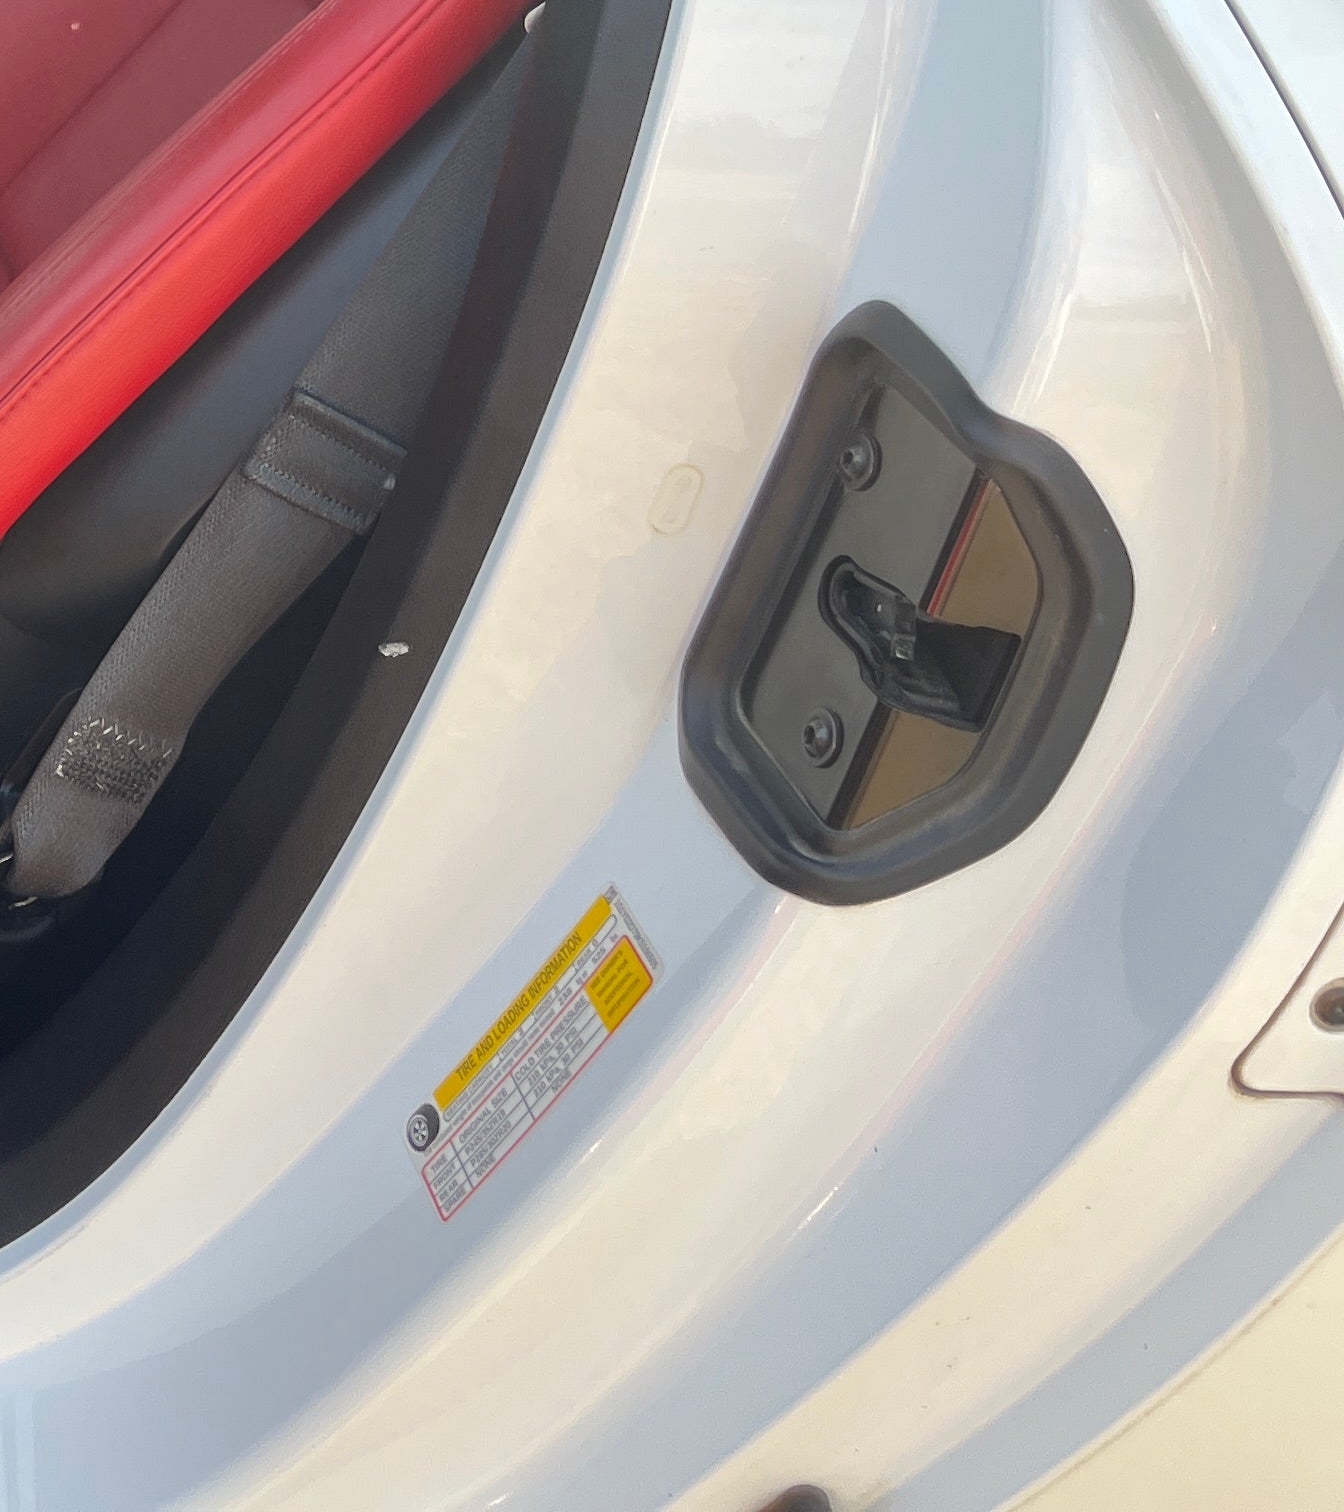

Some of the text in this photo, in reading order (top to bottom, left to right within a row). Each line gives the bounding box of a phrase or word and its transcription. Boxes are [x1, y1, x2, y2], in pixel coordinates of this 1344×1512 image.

[456, 1054, 477, 1082] TIRE
[475, 1034, 494, 1060] AND
[493, 993, 530, 1041] LOADING
[528, 931, 582, 1000] INFORMATION
[515, 1056, 535, 1083] COLD
[535, 1038, 551, 1059] TIRE
[550, 996, 586, 1041] PRESSURE
[551, 1068, 572, 1094] NONE
[458, 1087, 507, 1145] ORIGINAL SIZE
[431, 1154, 447, 1176] TIRE
[434, 1163, 456, 1191] FRONT
[475, 1153, 496, 1179] NONE
[439, 1179, 458, 1203] REAR
